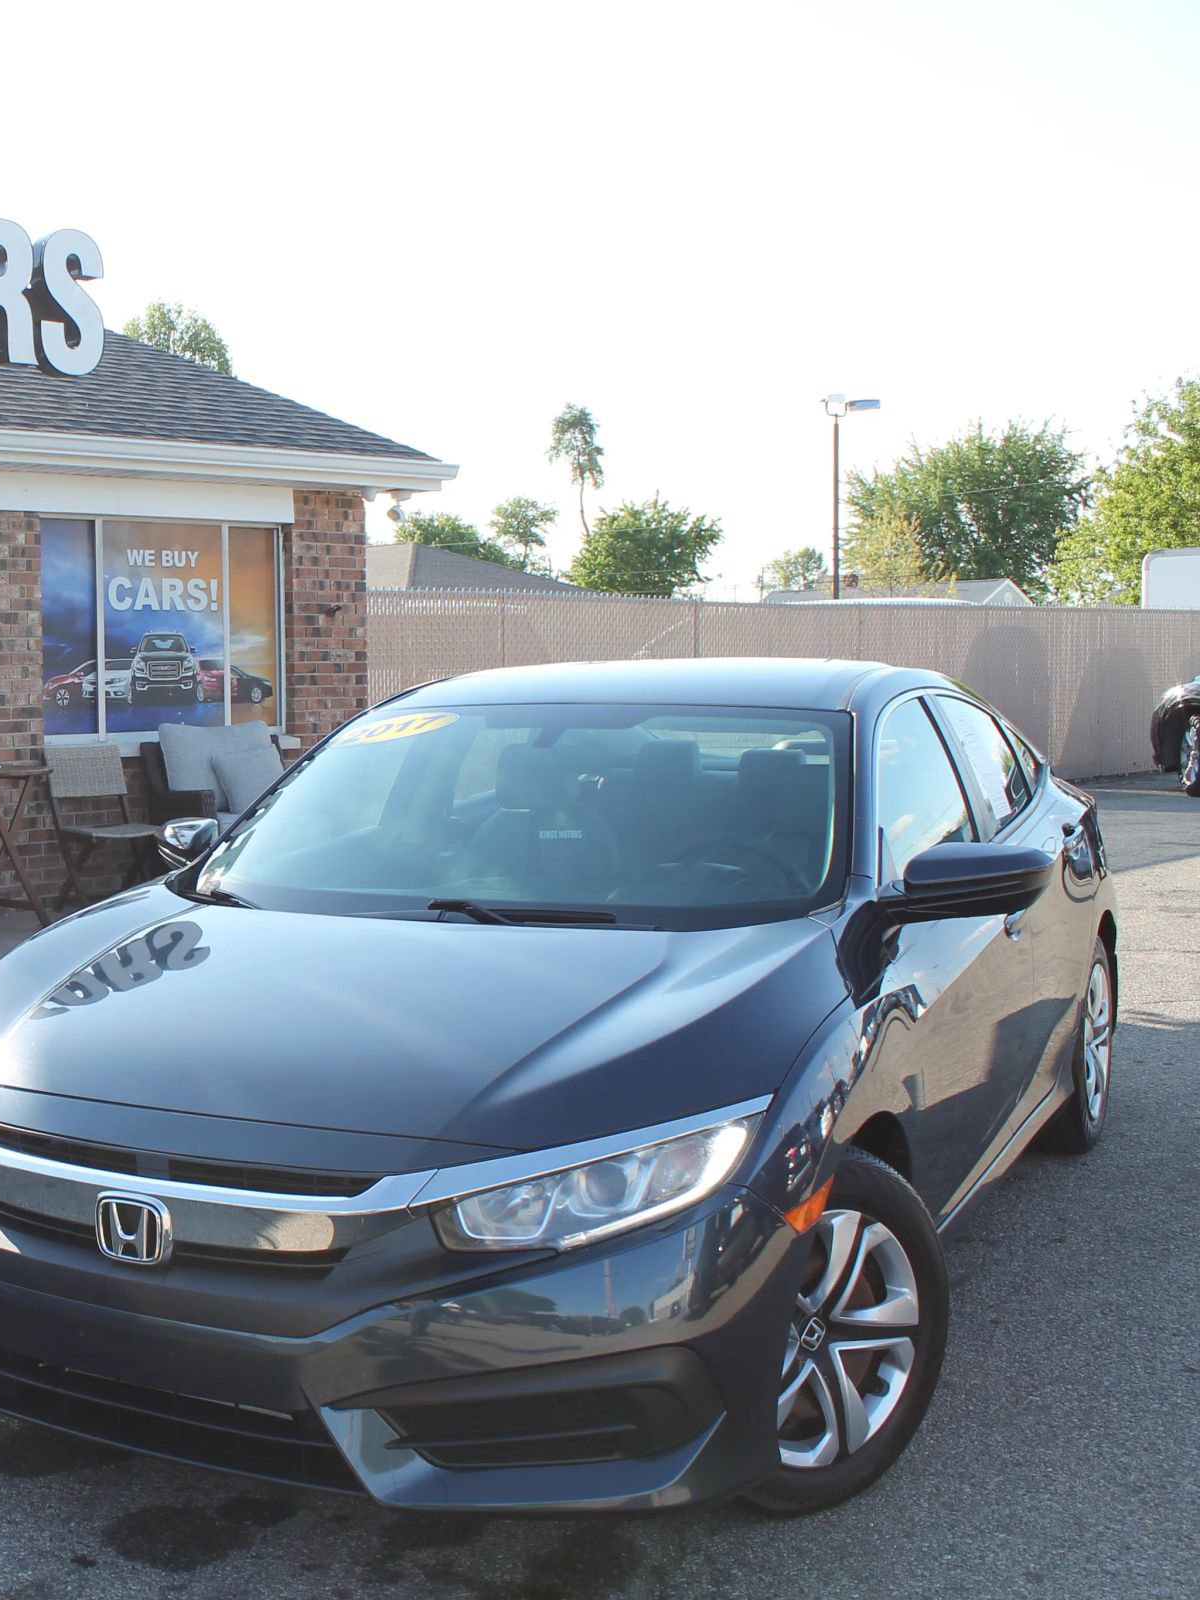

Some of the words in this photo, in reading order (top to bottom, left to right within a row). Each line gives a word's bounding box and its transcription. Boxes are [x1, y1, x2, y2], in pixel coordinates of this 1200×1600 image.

[126, 548, 156, 567] WE
[161, 550, 199, 568] BUY
[107, 576, 219, 612] CARS!
[340, 713, 448, 745] 2017
